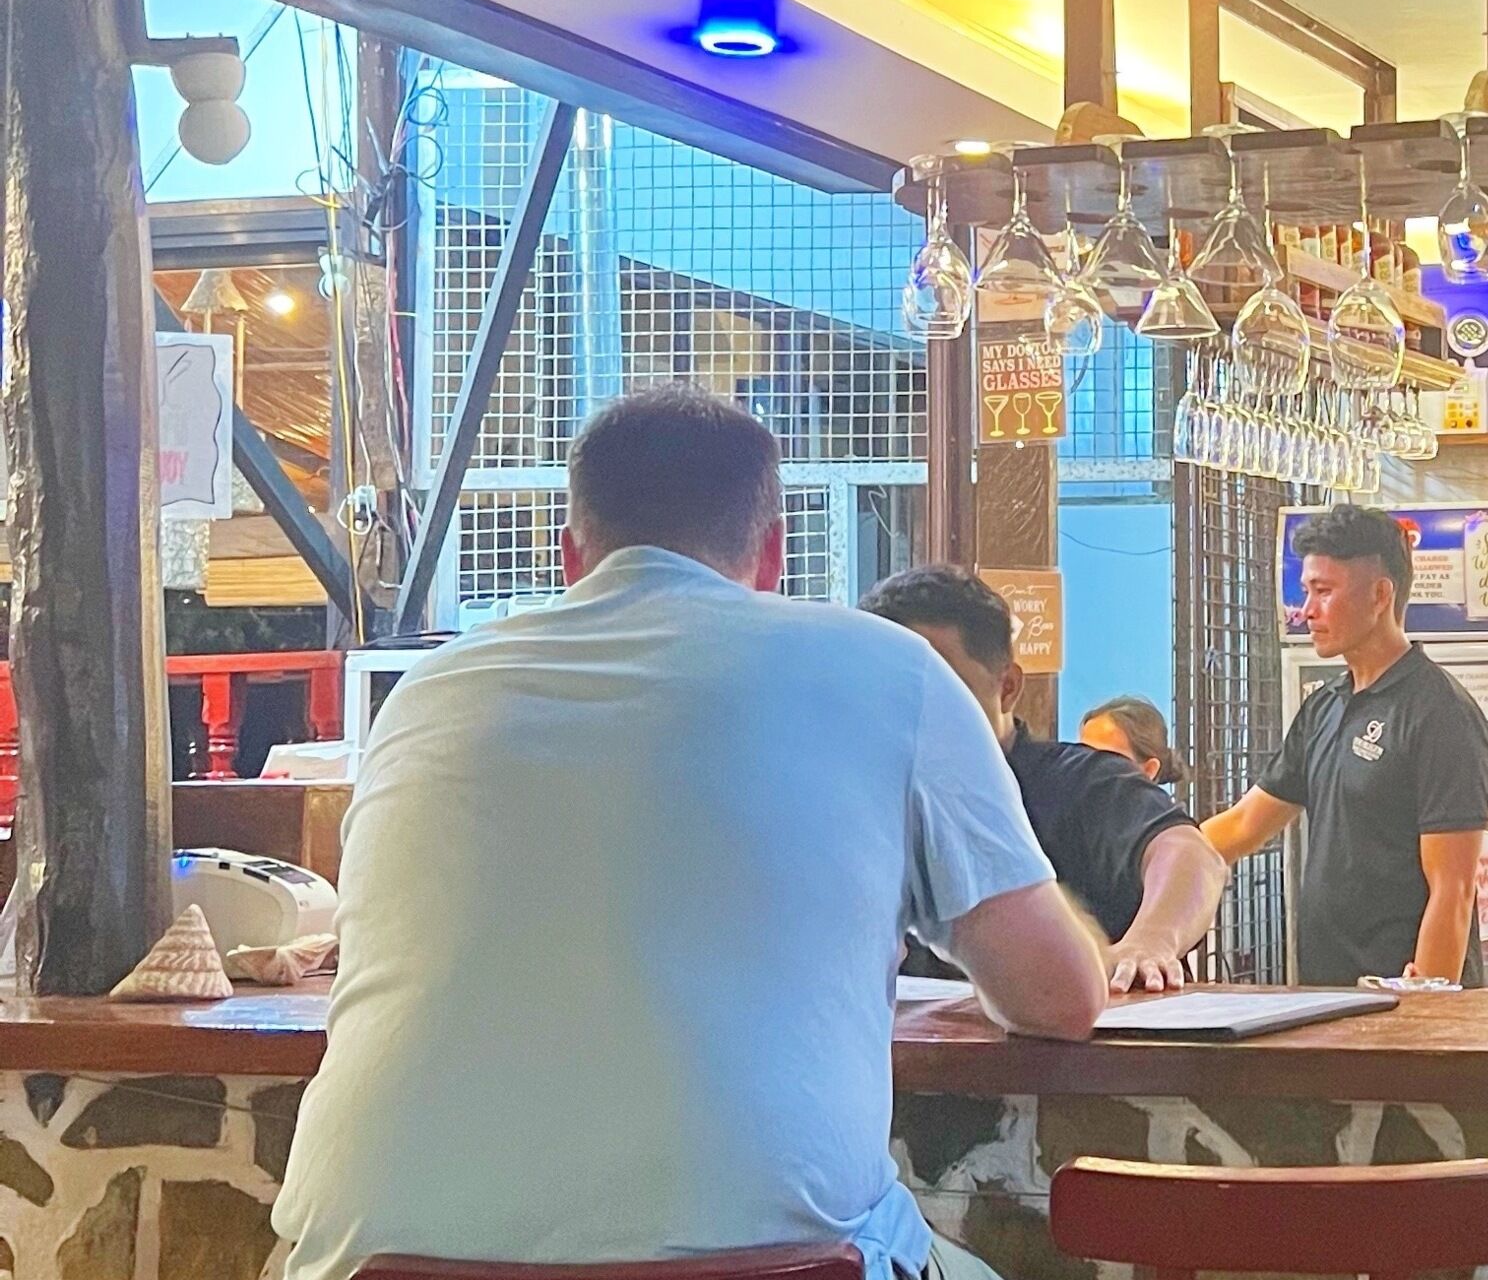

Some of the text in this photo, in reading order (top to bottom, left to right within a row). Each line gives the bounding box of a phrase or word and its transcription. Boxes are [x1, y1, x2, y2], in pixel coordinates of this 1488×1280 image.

[983, 340, 1060, 360] MY DOTO
[982, 355, 1061, 374] SAYS I NEED
[983, 370, 1063, 392] GLASSES
[1013, 598, 1048, 613] WORRY
[1019, 641, 1052, 656] HAPPY
